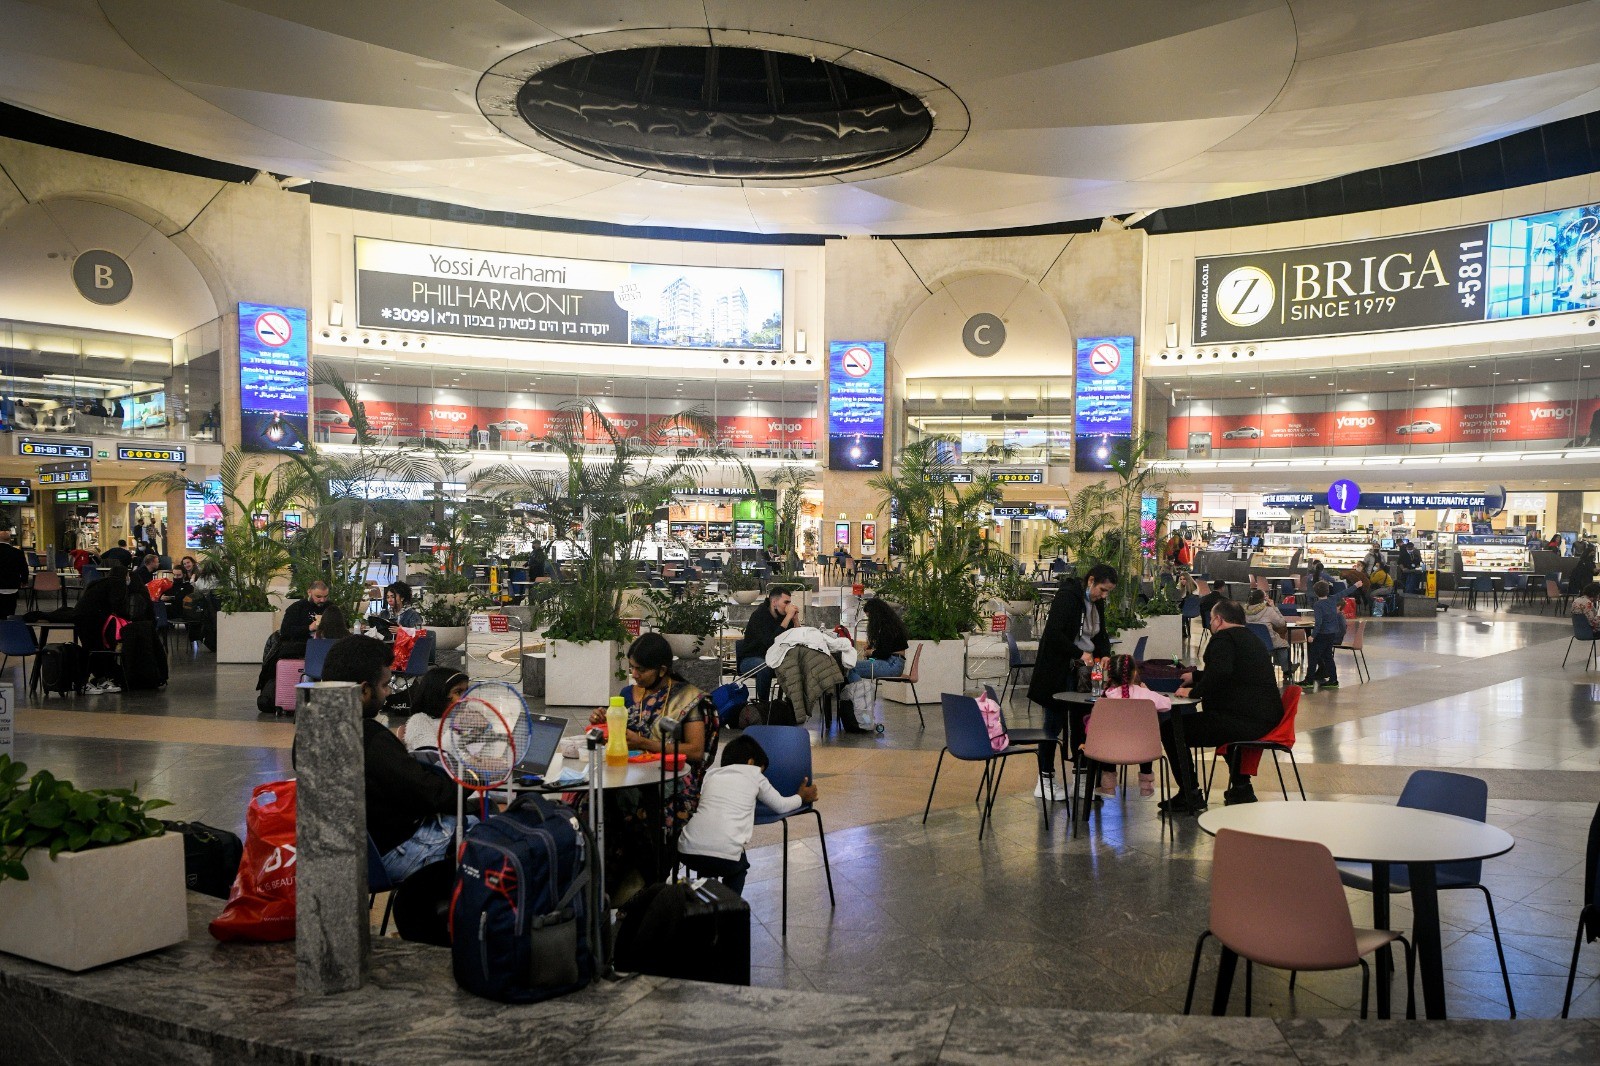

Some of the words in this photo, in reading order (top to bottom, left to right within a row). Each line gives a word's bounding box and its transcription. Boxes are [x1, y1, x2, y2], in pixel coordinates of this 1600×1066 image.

[429, 254, 473, 276] Yossi
[477, 259, 566, 284] Avrahami
[1292, 249, 1450, 302] BRIGA
[95, 265, 114, 289] B
[412, 281, 583, 316] PHILHARMONIT
[1200, 264, 1210, 337] WWW.BRIGA.CO.IL
[1232, 278, 1260, 315] Z
[1291, 301, 1349, 320] SINCE
[1355, 296, 1396, 313] 1979
[463, 314, 495, 328] בצפון
[498, 317, 536, 330] לפארק
[539, 320, 558, 332] הים
[562, 321, 577, 335] בין
[580, 323, 609, 336] יוקרה
[974, 324, 990, 345] C
[429, 410, 467, 423] yango
[1530, 408, 1574, 421] yango
[768, 421, 802, 433] yango
[1337, 416, 1375, 429] yango
[34, 446, 57, 454] B1-B9
[173, 452, 181, 460] B
[1301, 494, 1313, 502] CAFE
[1384, 496, 1410, 505] ILAN'S
[1412, 497, 1424, 505] THE
[1426, 497, 1468, 505] ALTERNATIVE
[1470, 497, 1485, 506] CAFE
